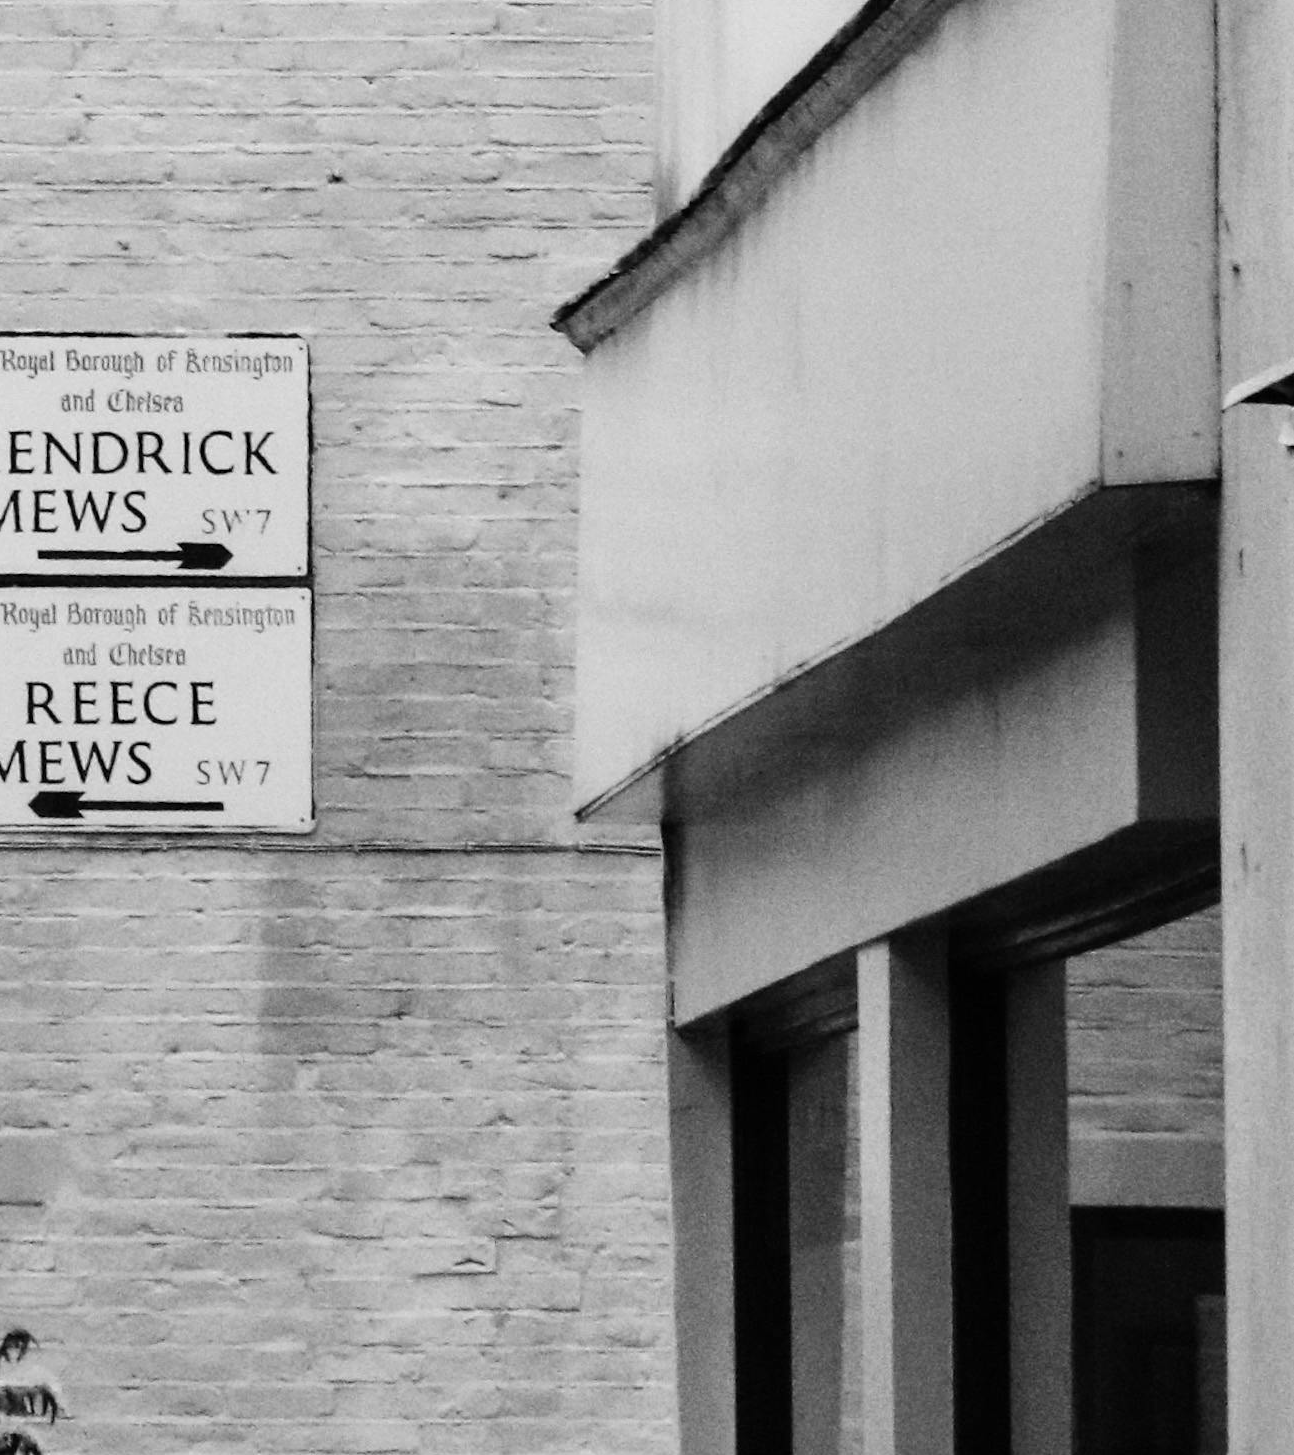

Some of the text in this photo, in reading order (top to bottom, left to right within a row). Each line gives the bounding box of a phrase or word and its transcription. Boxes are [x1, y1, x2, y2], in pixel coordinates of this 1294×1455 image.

[66, 350, 144, 379] Borough
[158, 350, 177, 373] of
[186, 348, 293, 380] Kensington
[61, 390, 184, 413] and Chelsea
[0, 602, 56, 632] Royal
[68, 602, 146, 632] Borough
[158, 602, 178, 626] of
[189, 601, 295, 633] Kensington
[64, 643, 186, 666] and Chelsea
[26, 681, 217, 725] REECE
